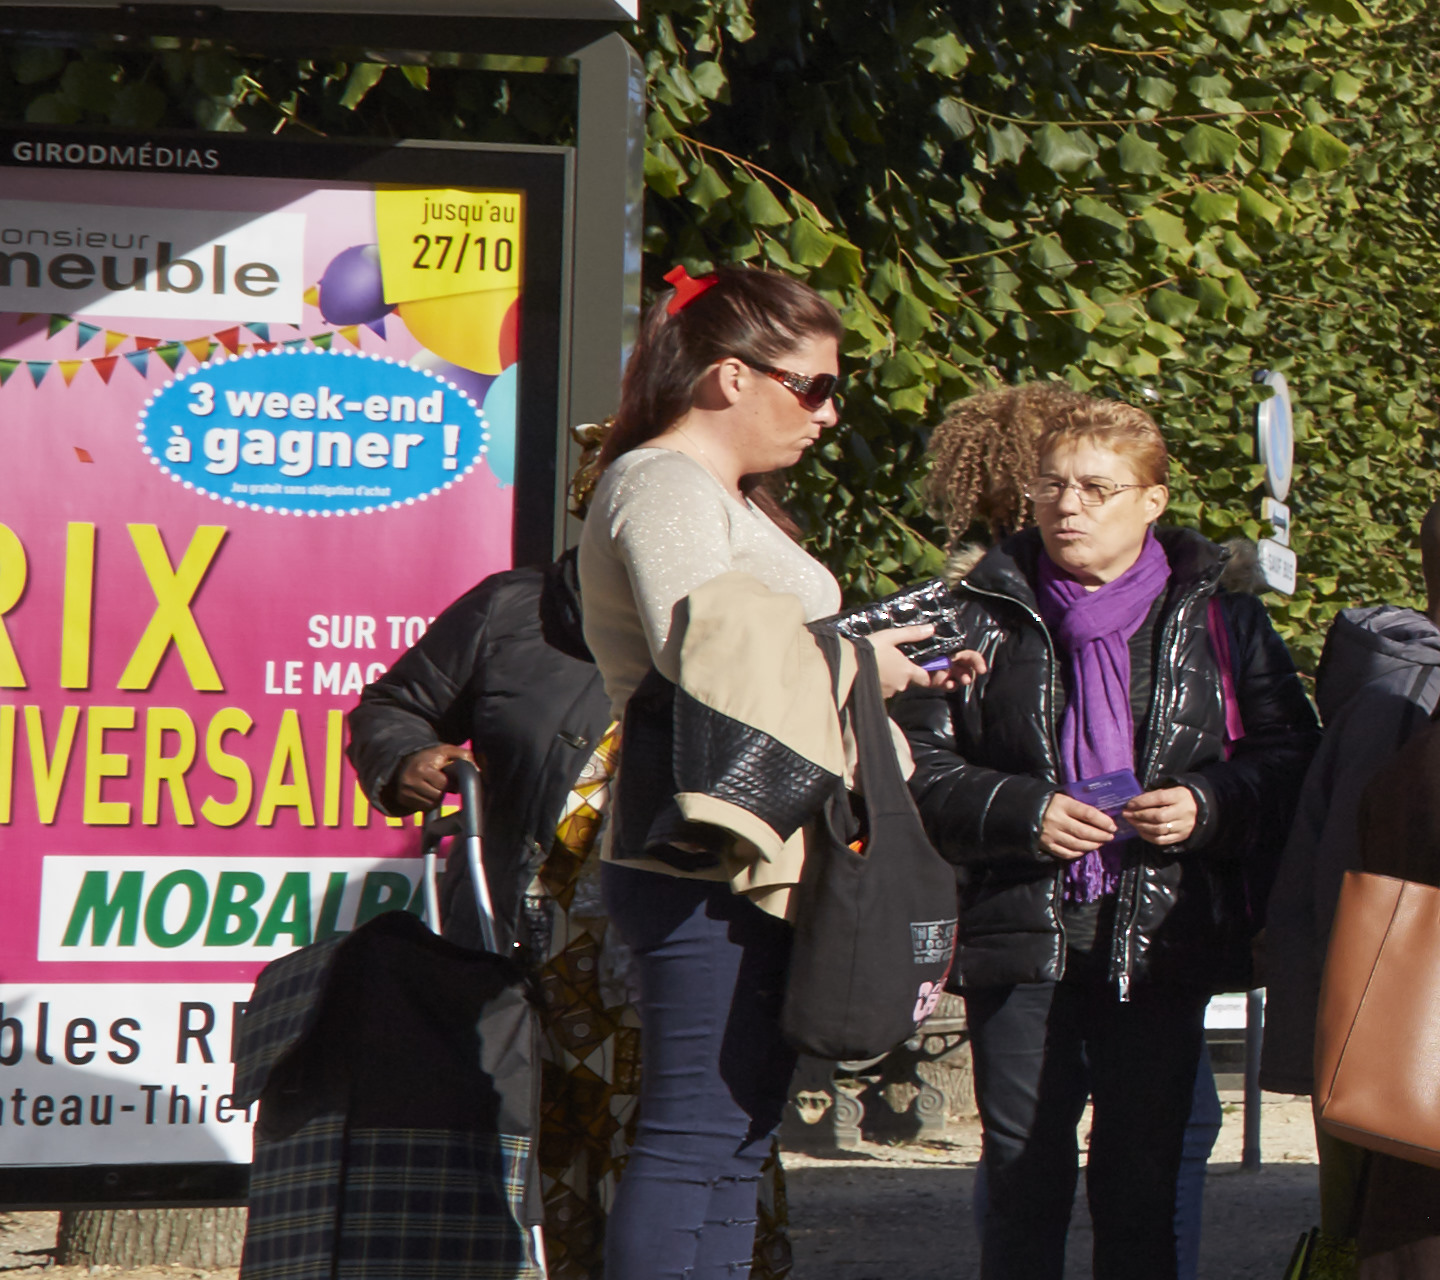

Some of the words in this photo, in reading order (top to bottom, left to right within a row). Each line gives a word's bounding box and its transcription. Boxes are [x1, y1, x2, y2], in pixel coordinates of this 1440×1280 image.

[12, 141, 221, 169] GIRODMÉDIAS
[421, 196, 516, 226] jusqu'au
[0, 227, 150, 251] onsieur
[411, 233, 514, 274] 27/10
[186, 382, 214, 416] 3
[225, 387, 443, 424] week-end
[165, 424, 193, 464] à
[204, 427, 424, 476] gagner
[441, 424, 460, 472] !
[308, 484, 354, 497] obligation
[307, 614, 377, 649] SUR
[386, 616, 437, 650] TO
[264, 660, 304, 695] LE
[0, 1084, 251, 1127] teau-Thie
